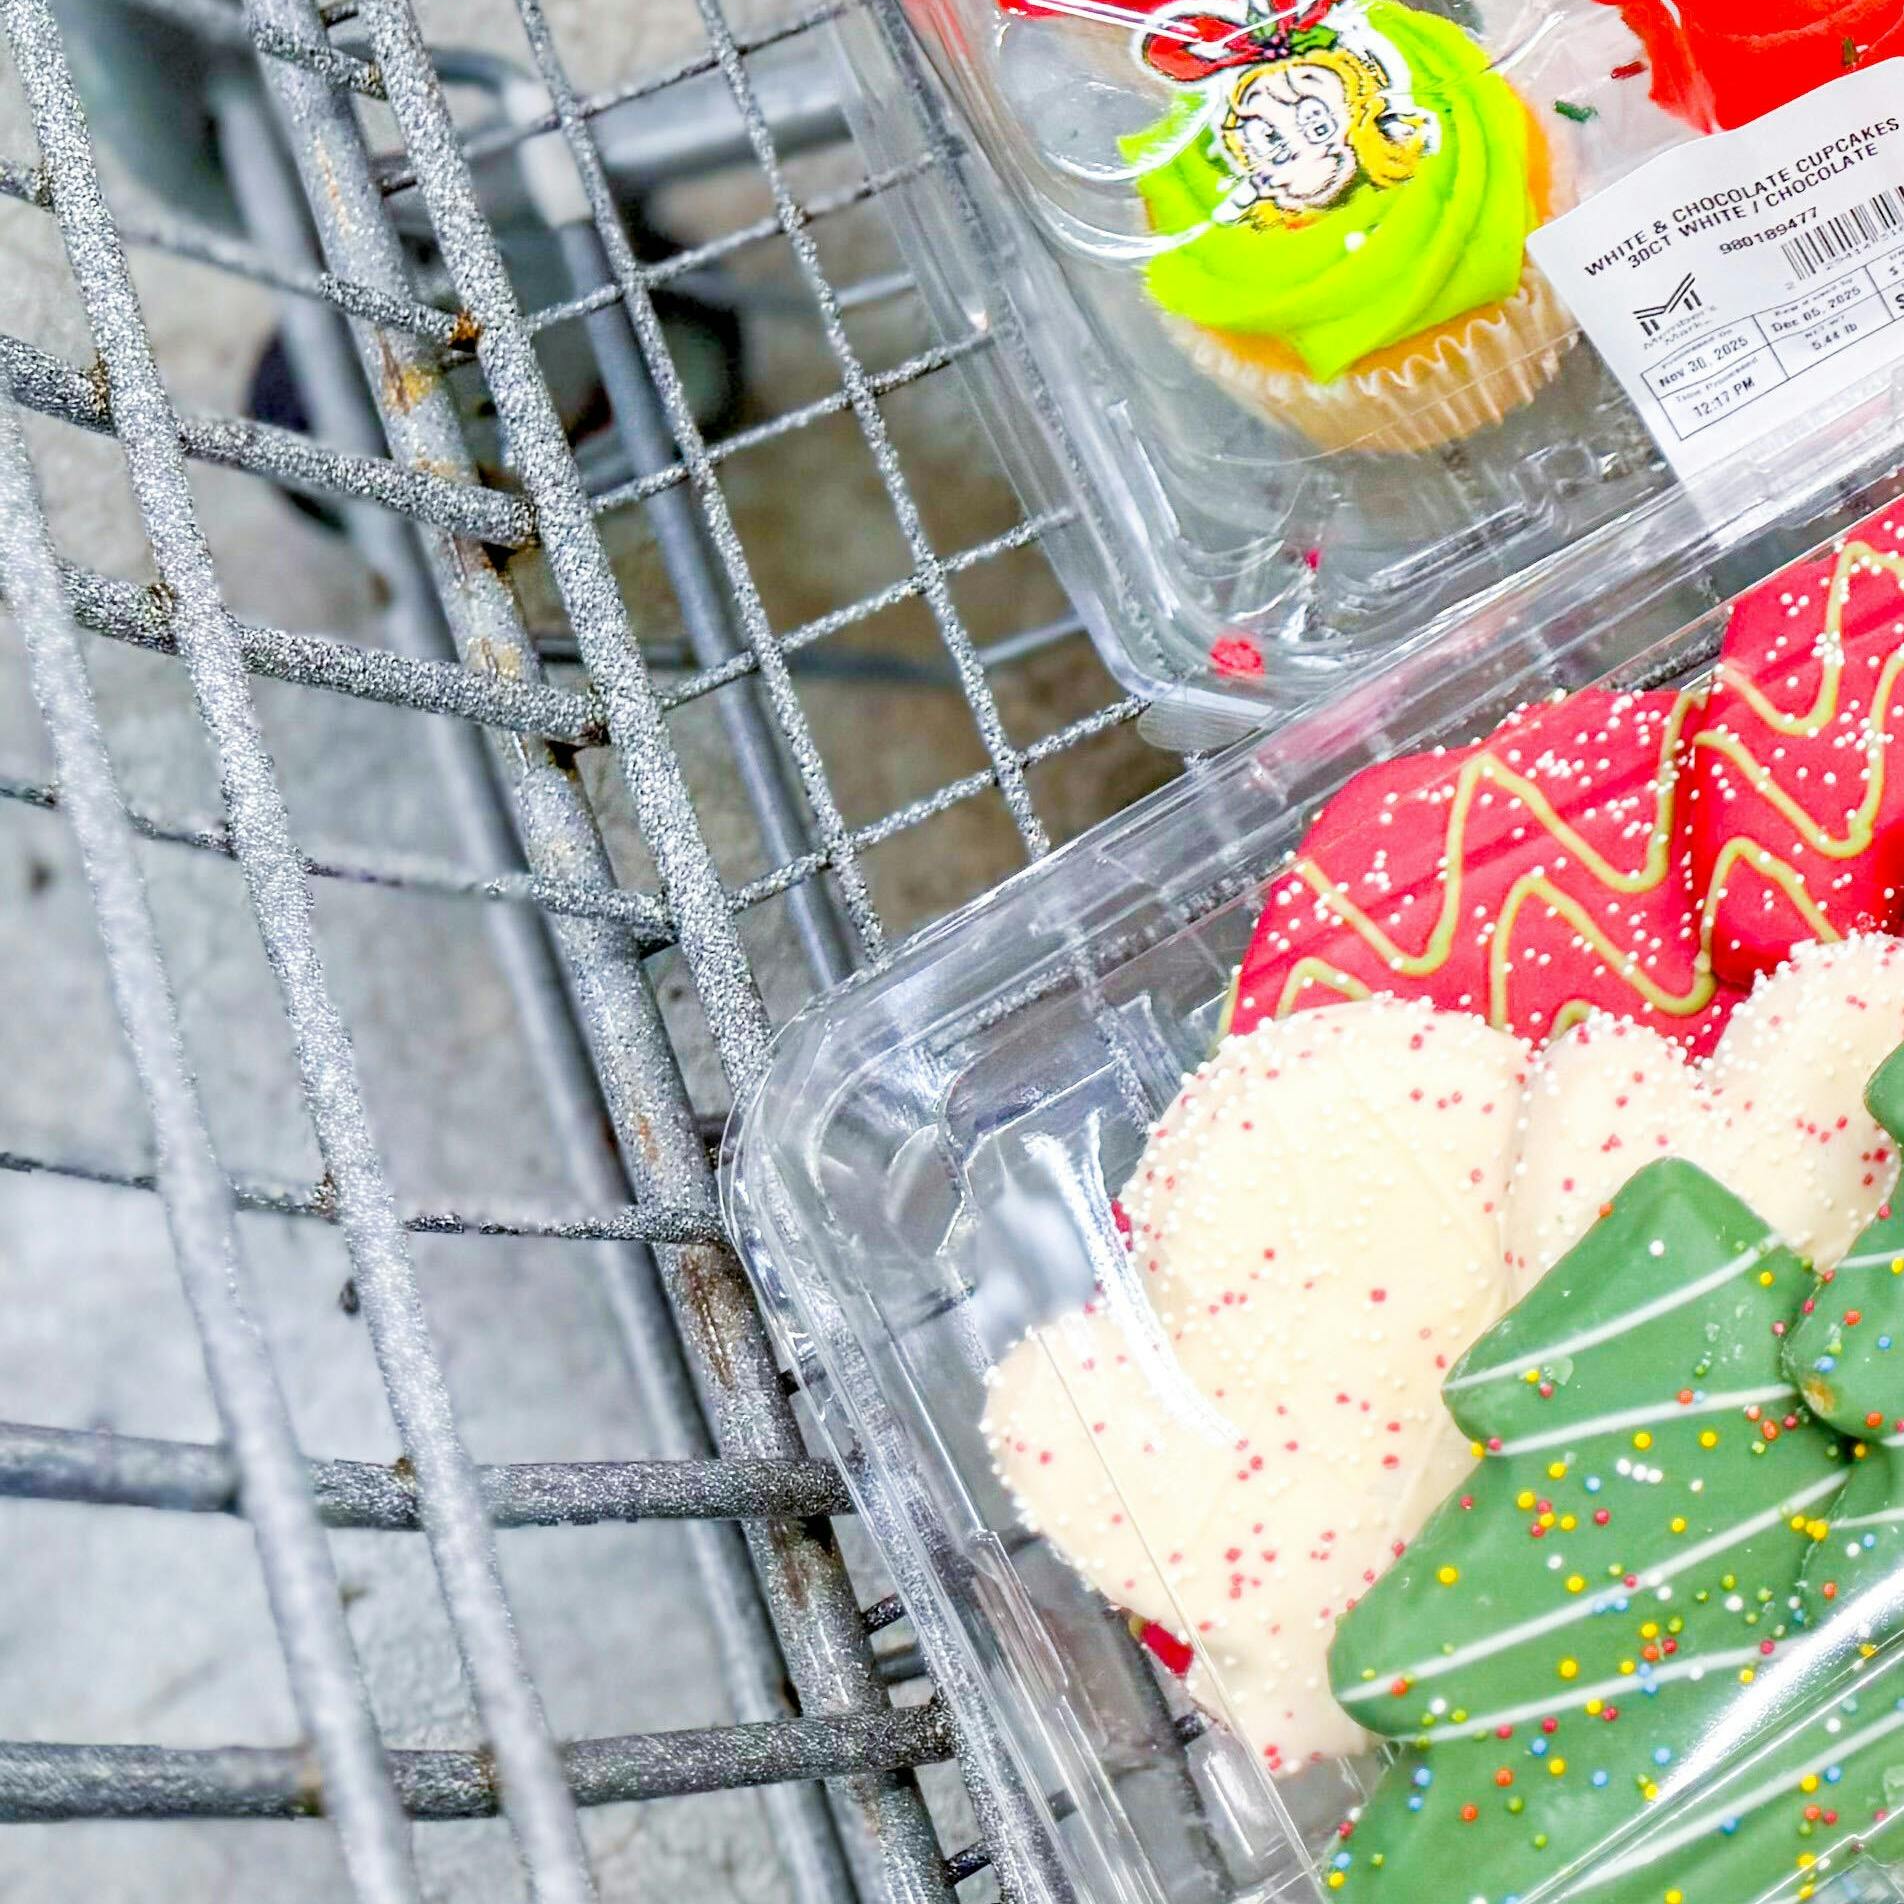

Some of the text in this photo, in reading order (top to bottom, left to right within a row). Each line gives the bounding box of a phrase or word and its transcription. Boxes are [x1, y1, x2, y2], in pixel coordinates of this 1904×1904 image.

[1585, 118, 1899, 276] WHITE & CHOCOLATE CUPCAKES
[1628, 235, 1671, 268] 30CT
[1678, 206, 1746, 236] WHITE
[1765, 143, 1878, 206] CHOCOLATE
[1720, 207, 1816, 254] 980189477
[1770, 318, 1798, 333] Dec
[1844, 322, 1857, 334] lb
[1658, 369, 1685, 387] Nov
[1714, 337, 1748, 360] 2025
[1693, 376, 1754, 416] 12:17 PM
